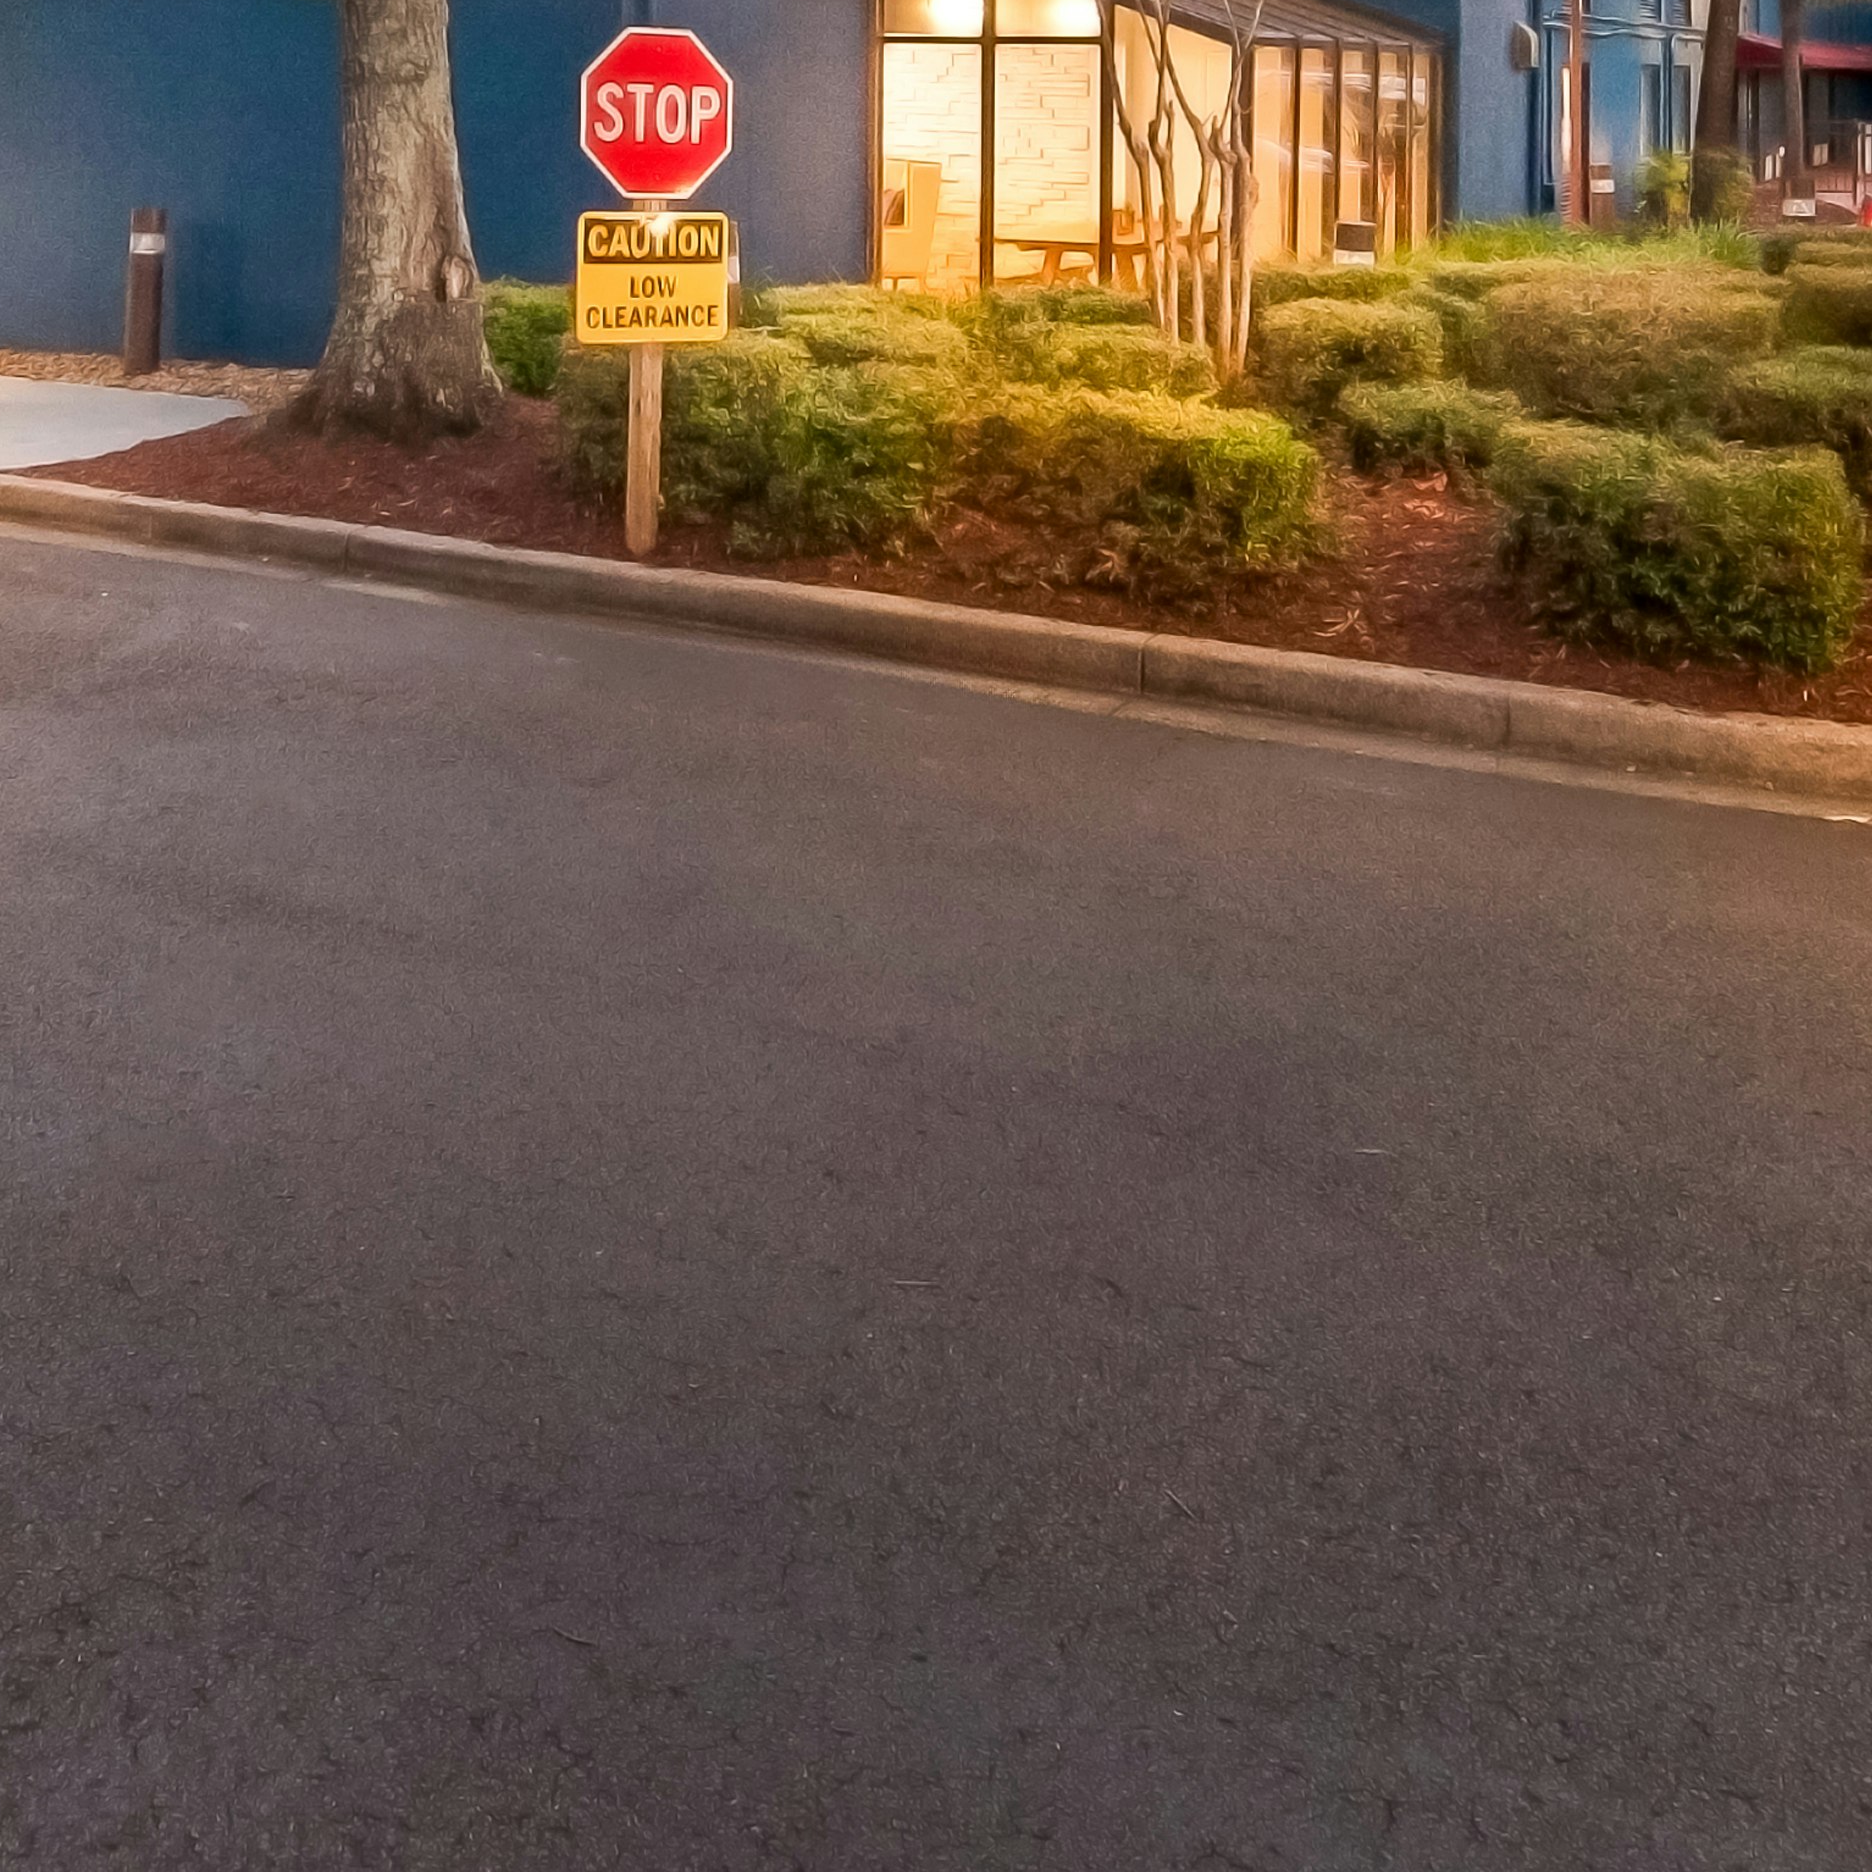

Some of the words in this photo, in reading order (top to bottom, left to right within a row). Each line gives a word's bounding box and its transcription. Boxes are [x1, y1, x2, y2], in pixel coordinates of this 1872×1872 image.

[594, 82, 721, 144] STOP
[587, 224, 719, 259] CAUTION
[630, 275, 677, 299] LOW
[586, 304, 719, 329] CLEARANCE
